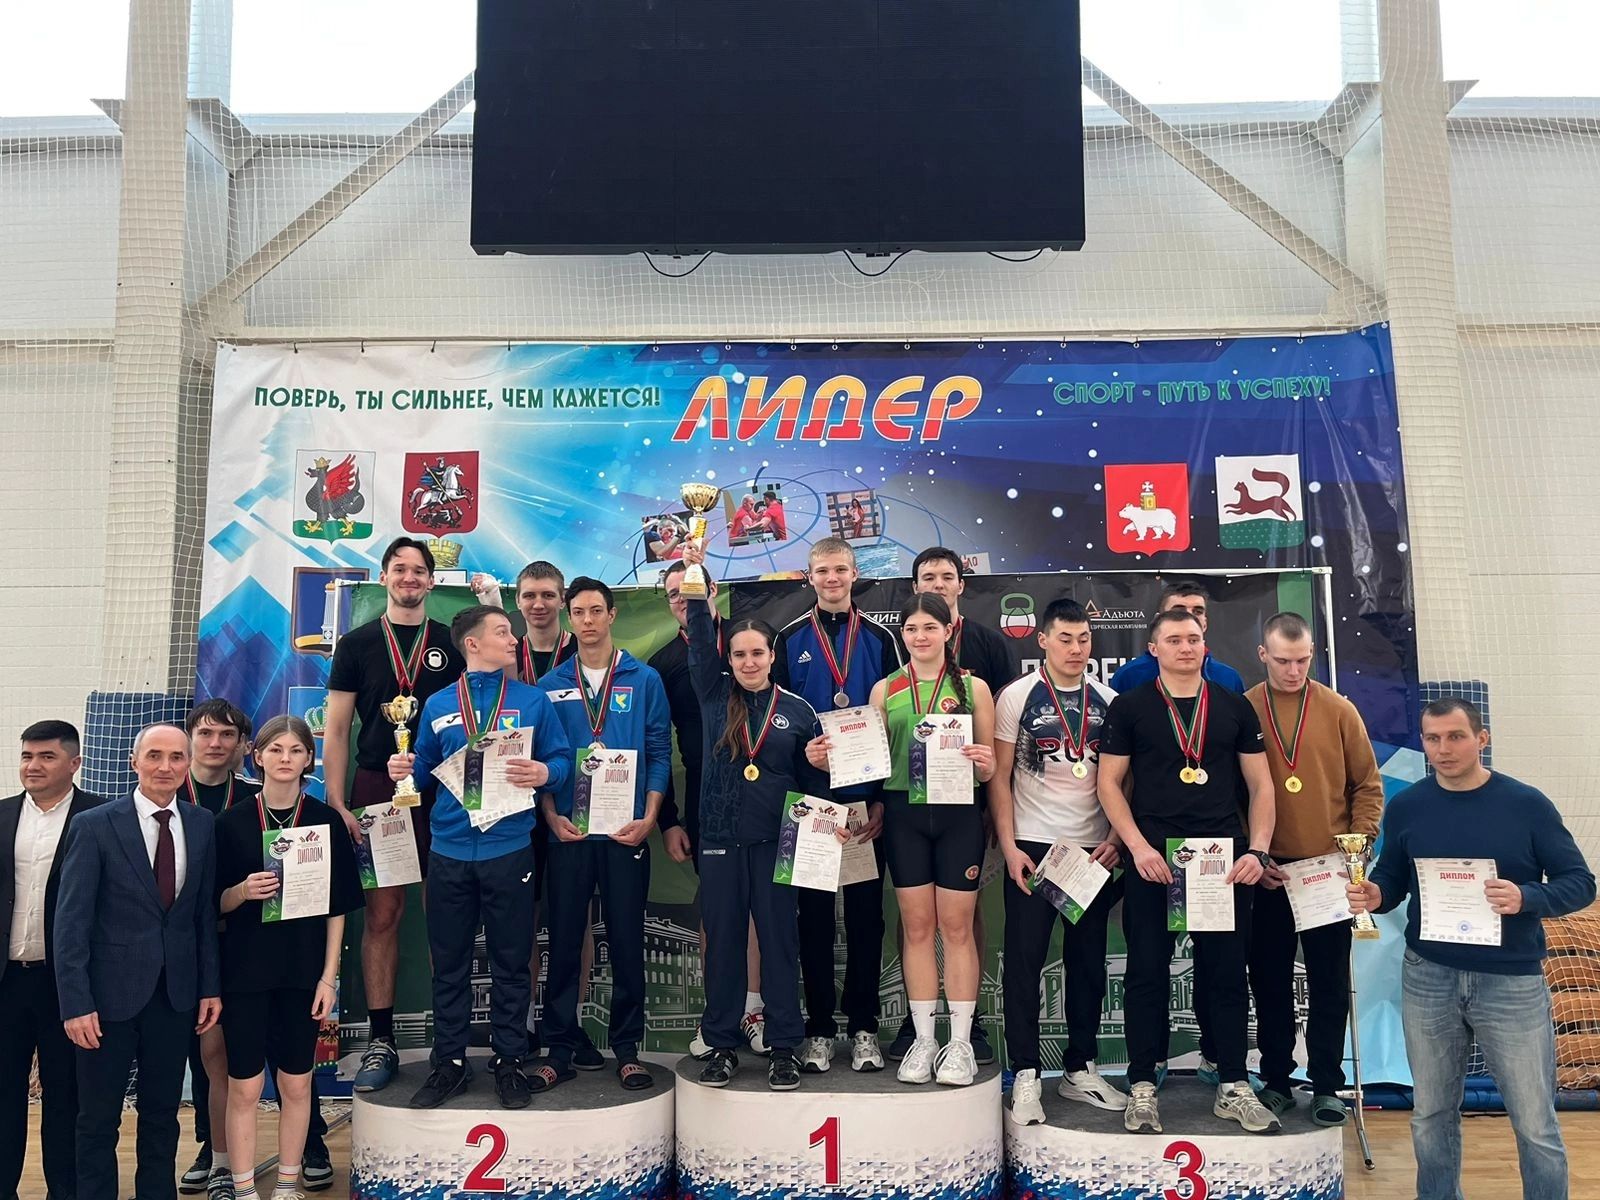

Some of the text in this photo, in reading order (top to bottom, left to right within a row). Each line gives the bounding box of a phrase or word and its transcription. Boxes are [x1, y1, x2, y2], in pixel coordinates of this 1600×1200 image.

[254, 386, 660, 412] ПОВЕРЬ, ТЫ СИЛЬНЕЕ, ЧЕМ КАЖЕТСЯ!
[1053, 382, 1136, 405] СПОРТ
[1158, 380, 1211, 403] ПУТЬ
[1217, 380, 1231, 400] К
[1238, 375, 1331, 400] УСПЕХУ!
[671, 375, 983, 441] ЛИДЕР
[840, 721, 867, 733] ДИПЛОМ
[297, 846, 324, 865] ДИПЛОМ
[1302, 871, 1332, 886] ДИПЛОМ
[1439, 871, 1476, 881] ДИПЛОМ
[462, 1122, 509, 1193] 2
[808, 1116, 841, 1187] 1
[1162, 1139, 1210, 1200] 3
